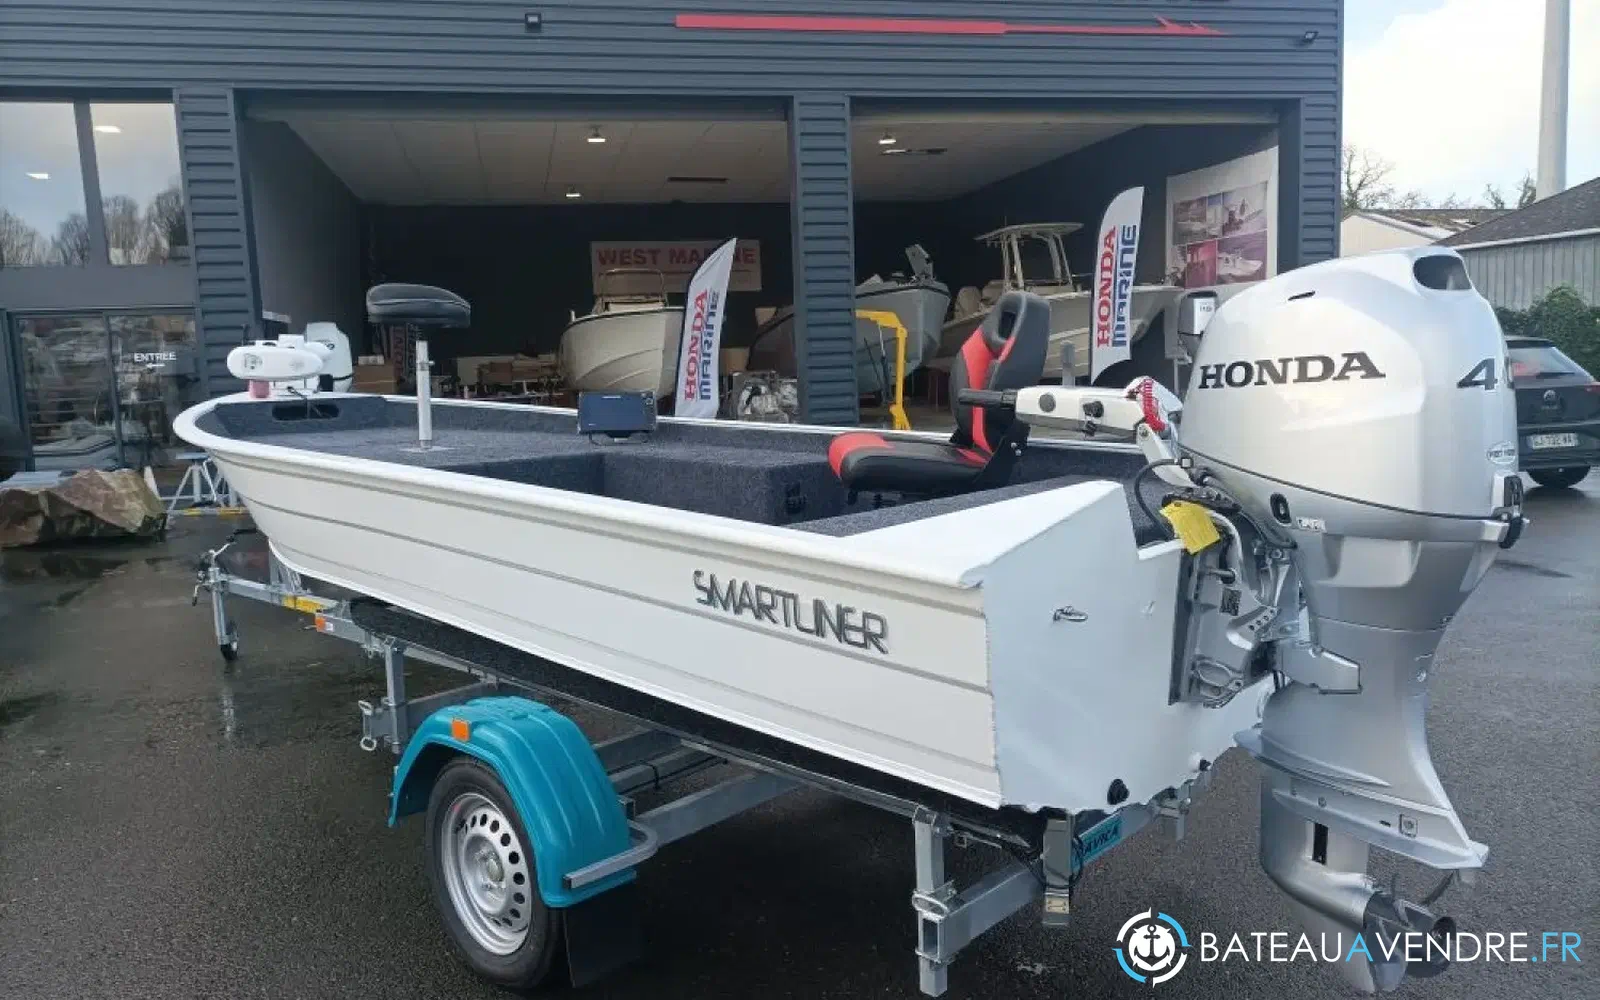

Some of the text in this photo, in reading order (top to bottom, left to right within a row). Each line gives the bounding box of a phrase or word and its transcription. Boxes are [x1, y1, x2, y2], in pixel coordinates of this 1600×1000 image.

[597, 248, 661, 265] WEST
[1097, 225, 1117, 347] HONDA
[1112, 225, 1137, 347] MARINE
[684, 288, 708, 400] HONDA
[1198, 351, 1386, 389] HONDA
[693, 570, 889, 655] SMARTLINER
